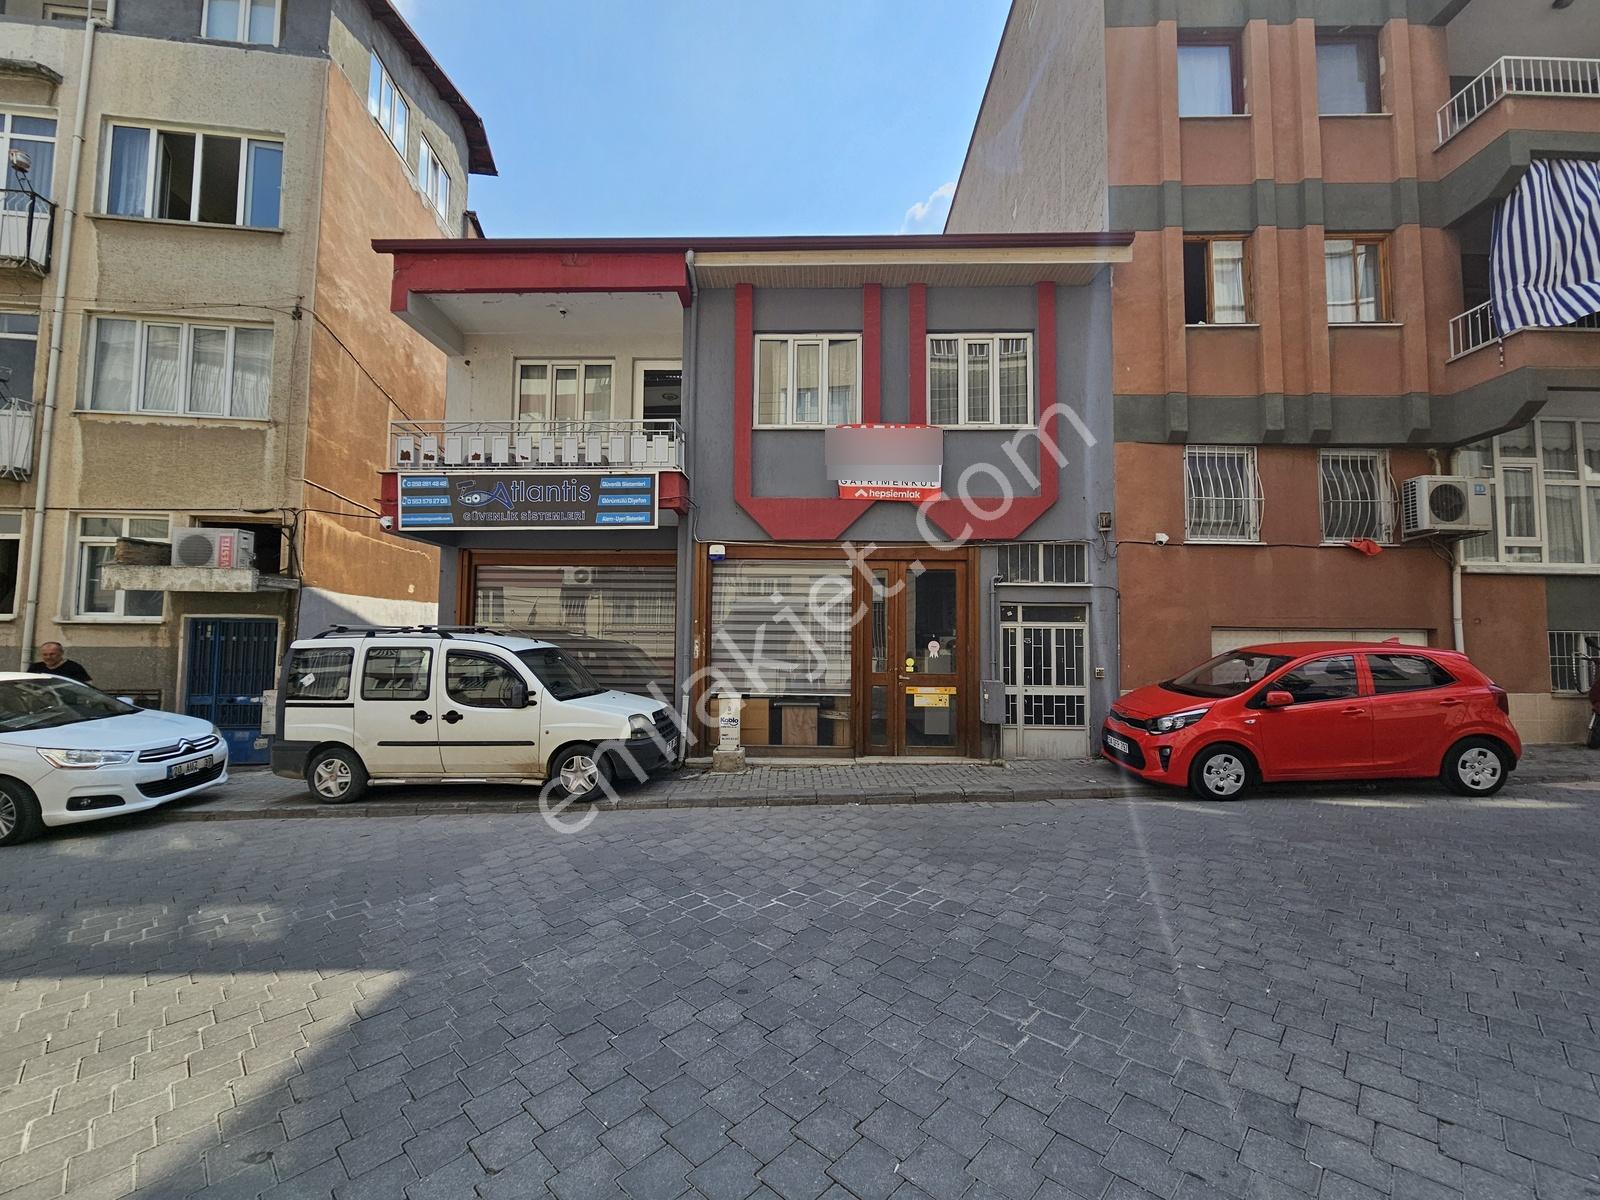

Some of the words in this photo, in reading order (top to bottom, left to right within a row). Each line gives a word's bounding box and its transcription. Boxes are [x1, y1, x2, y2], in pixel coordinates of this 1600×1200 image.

[493, 479, 591, 510] Atlantis
[869, 489, 920, 498] hepsiemlak
[462, 510, 518, 521] GÜVENLİK
[520, 510, 585, 521] SİSTEMLERİ
